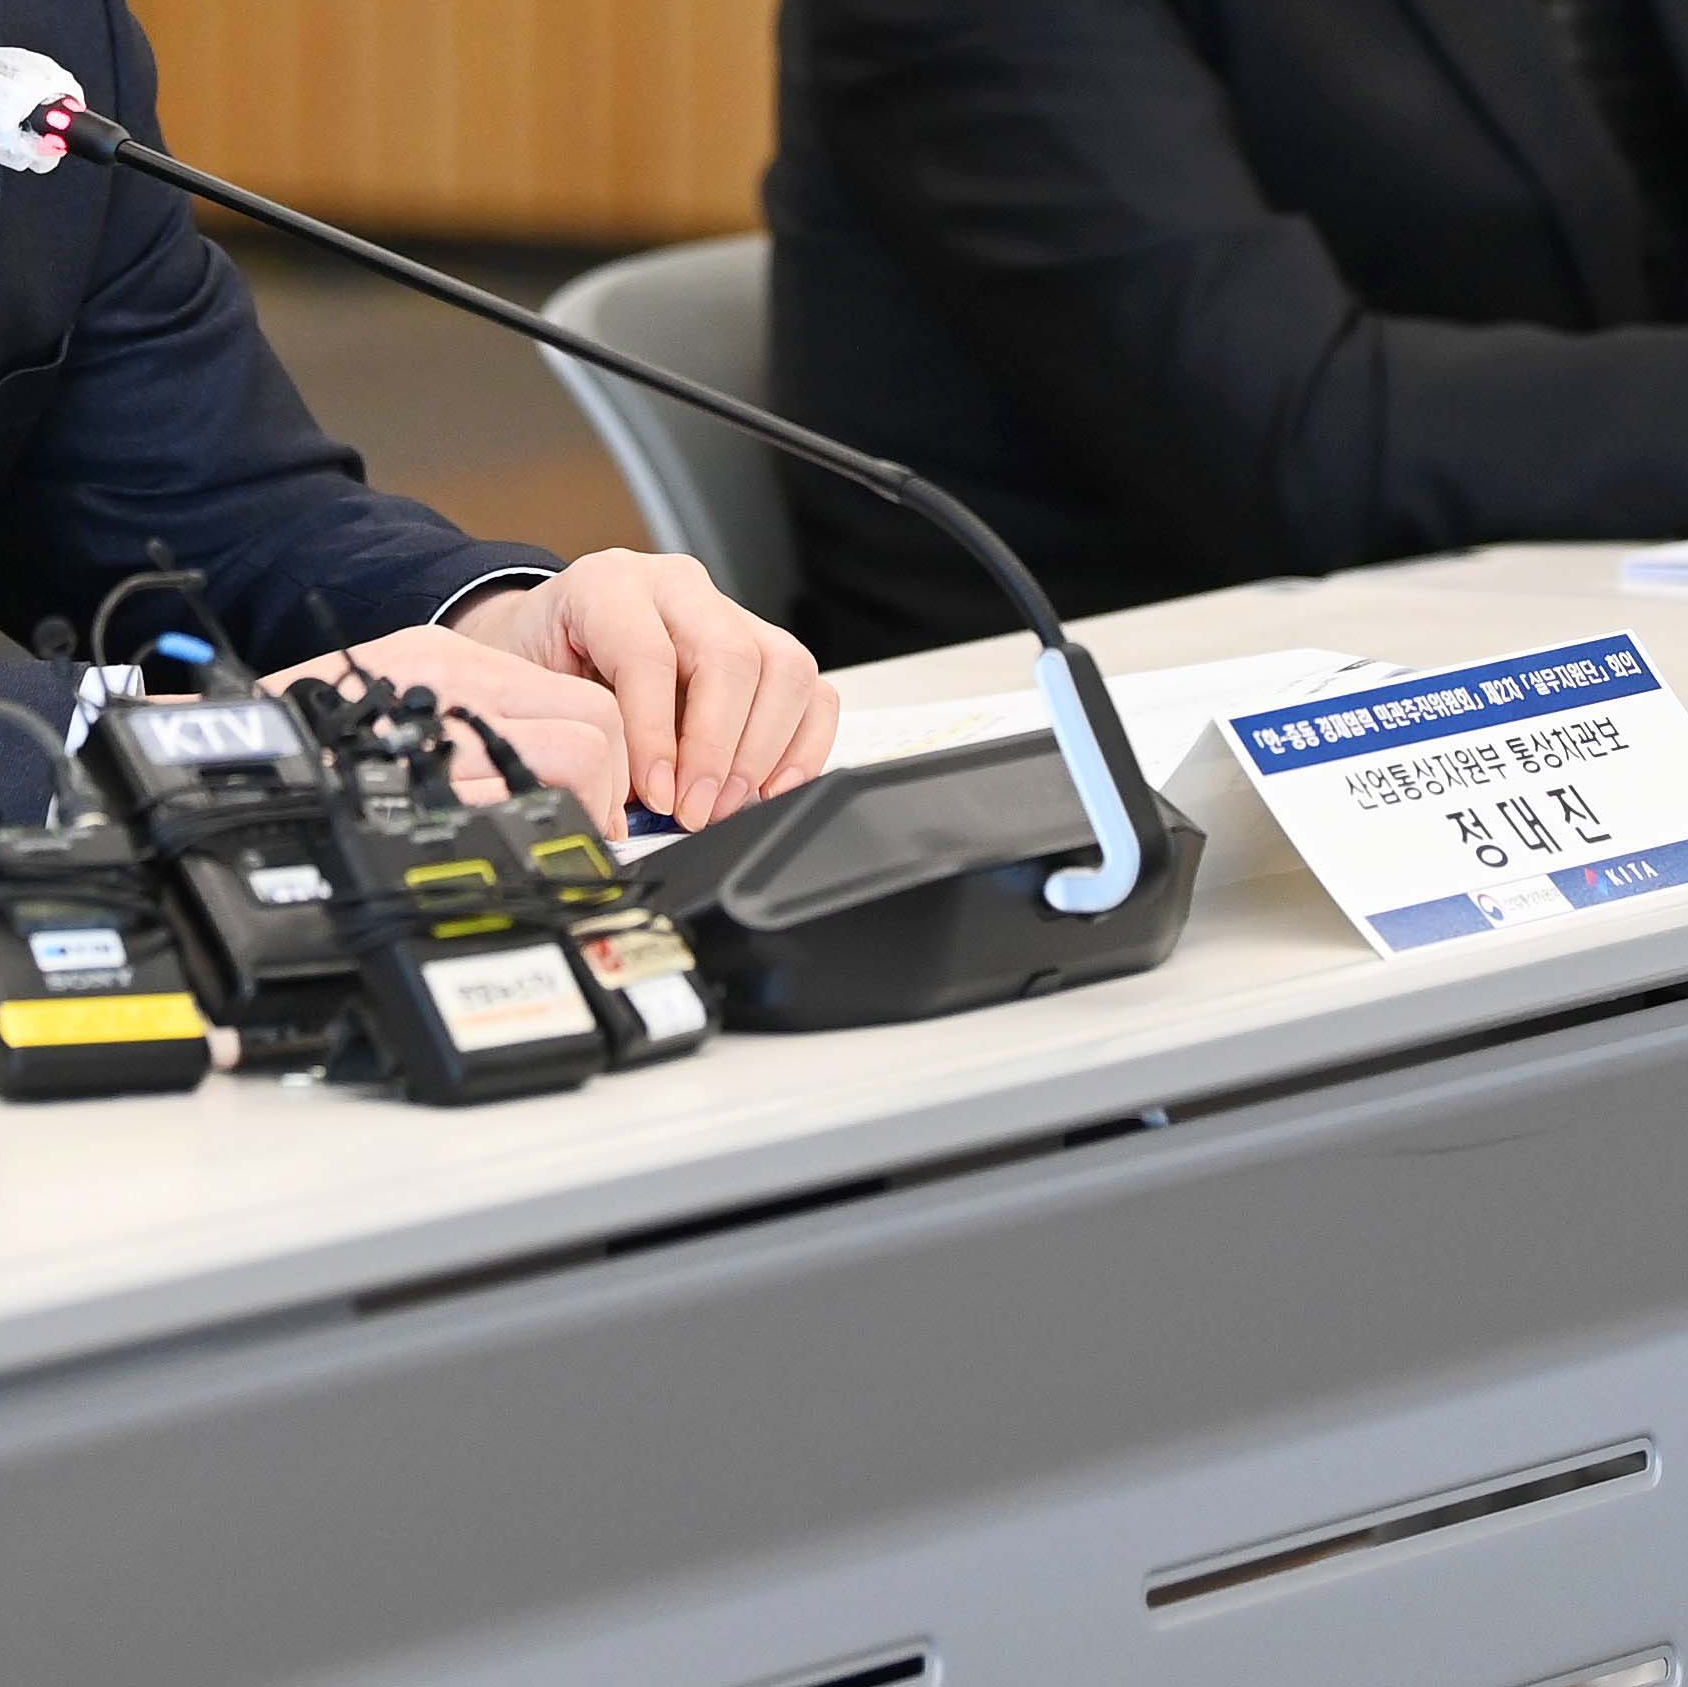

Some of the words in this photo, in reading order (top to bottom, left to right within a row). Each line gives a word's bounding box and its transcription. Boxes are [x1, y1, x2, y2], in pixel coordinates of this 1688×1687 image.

[148, 705, 266, 757] KTV
[1315, 706, 1380, 743] 경제협력
[1478, 675, 1525, 706] 제2차
[1604, 650, 1643, 679] 회의
[1344, 743, 1507, 811] 산업통상자원부
[1505, 716, 1630, 774] 통상차관보
[1604, 860, 1659, 888] KITA
